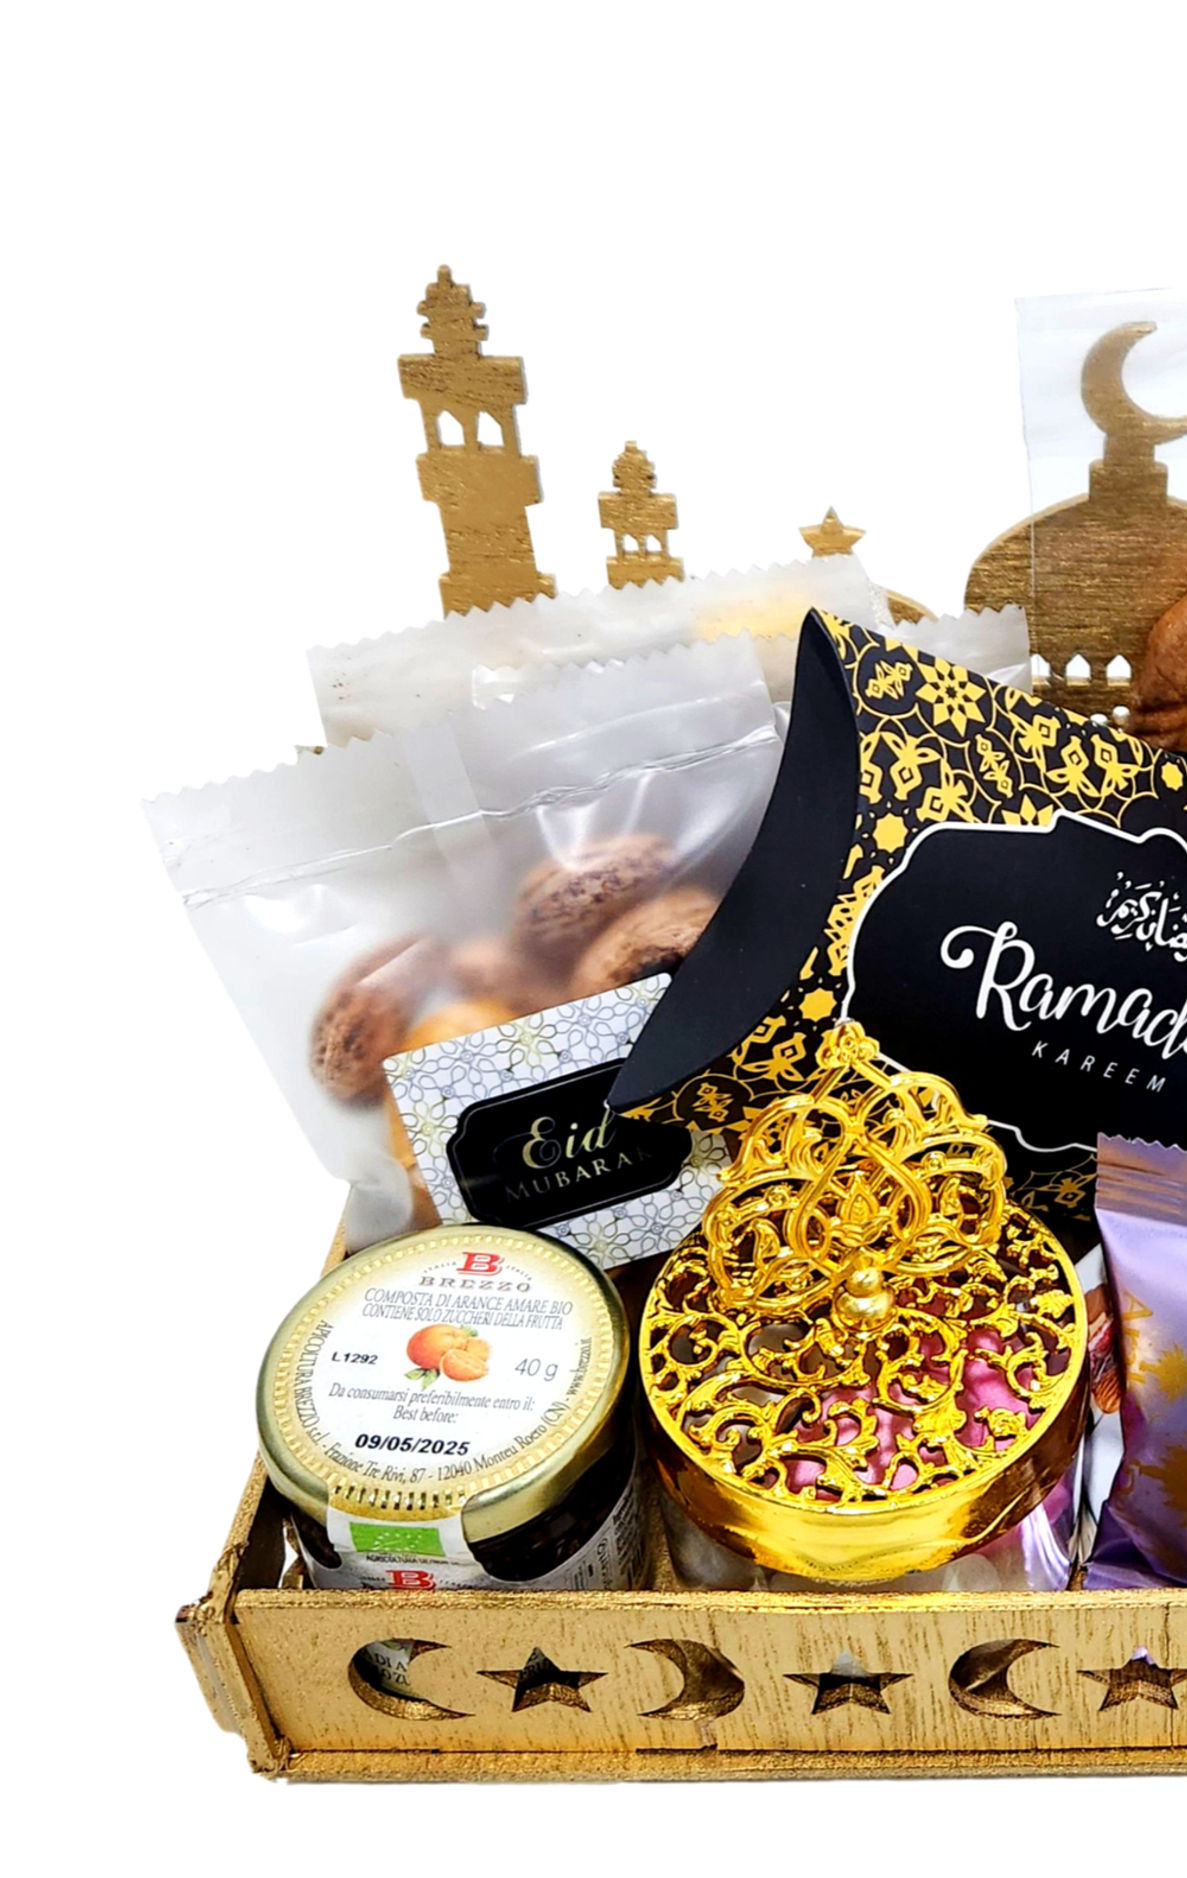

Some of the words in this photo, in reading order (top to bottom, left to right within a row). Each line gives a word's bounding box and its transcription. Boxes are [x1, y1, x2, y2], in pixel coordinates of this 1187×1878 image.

[1031, 1040, 1167, 1094] KAREEM
[493, 1104, 616, 1169] Eid
[456, 1252, 505, 1276] B
[419, 1276, 531, 1293] BREZZO
[365, 1288, 433, 1306] COMPOSTA
[436, 1294, 452, 1307] DI
[452, 1295, 504, 1311] ARANCE
[503, 1299, 549, 1313] AMARE
[549, 1301, 573, 1315] BIO
[362, 1303, 415, 1320] CONTIENE
[415, 1307, 442, 1322] SOLO
[442, 1309, 494, 1326] ZUCCHERI
[493, 1312, 524, 1328] DELLA
[525, 1314, 563, 1330] FRUTTA
[294, 1319, 335, 1387] APICOLTURA
[331, 1351, 379, 1365] L1292
[514, 1358, 542, 1377] 40
[544, 1363, 559, 1382] g
[294, 1386, 320, 1428] BREZZO
[328, 1382, 345, 1398] Da
[347, 1387, 410, 1403] consumarsi
[407, 1389, 492, 1408] preferibilmente
[493, 1398, 520, 1410] entro
[393, 1405, 418, 1421] Best
[419, 1407, 459, 1424] before:
[540, 1401, 571, 1427] (CN)
[354, 1433, 470, 1456] 09/05/2025
[514, 1425, 548, 1450] Roero
[324, 1441, 364, 1473] Frazione
[362, 1460, 381, 1479] Tre
[473, 1445, 519, 1472] Monteu
[409, 1468, 427, 1484] 87
[437, 1460, 472, 1482] 12040
[385, 1570, 437, 1590] B
